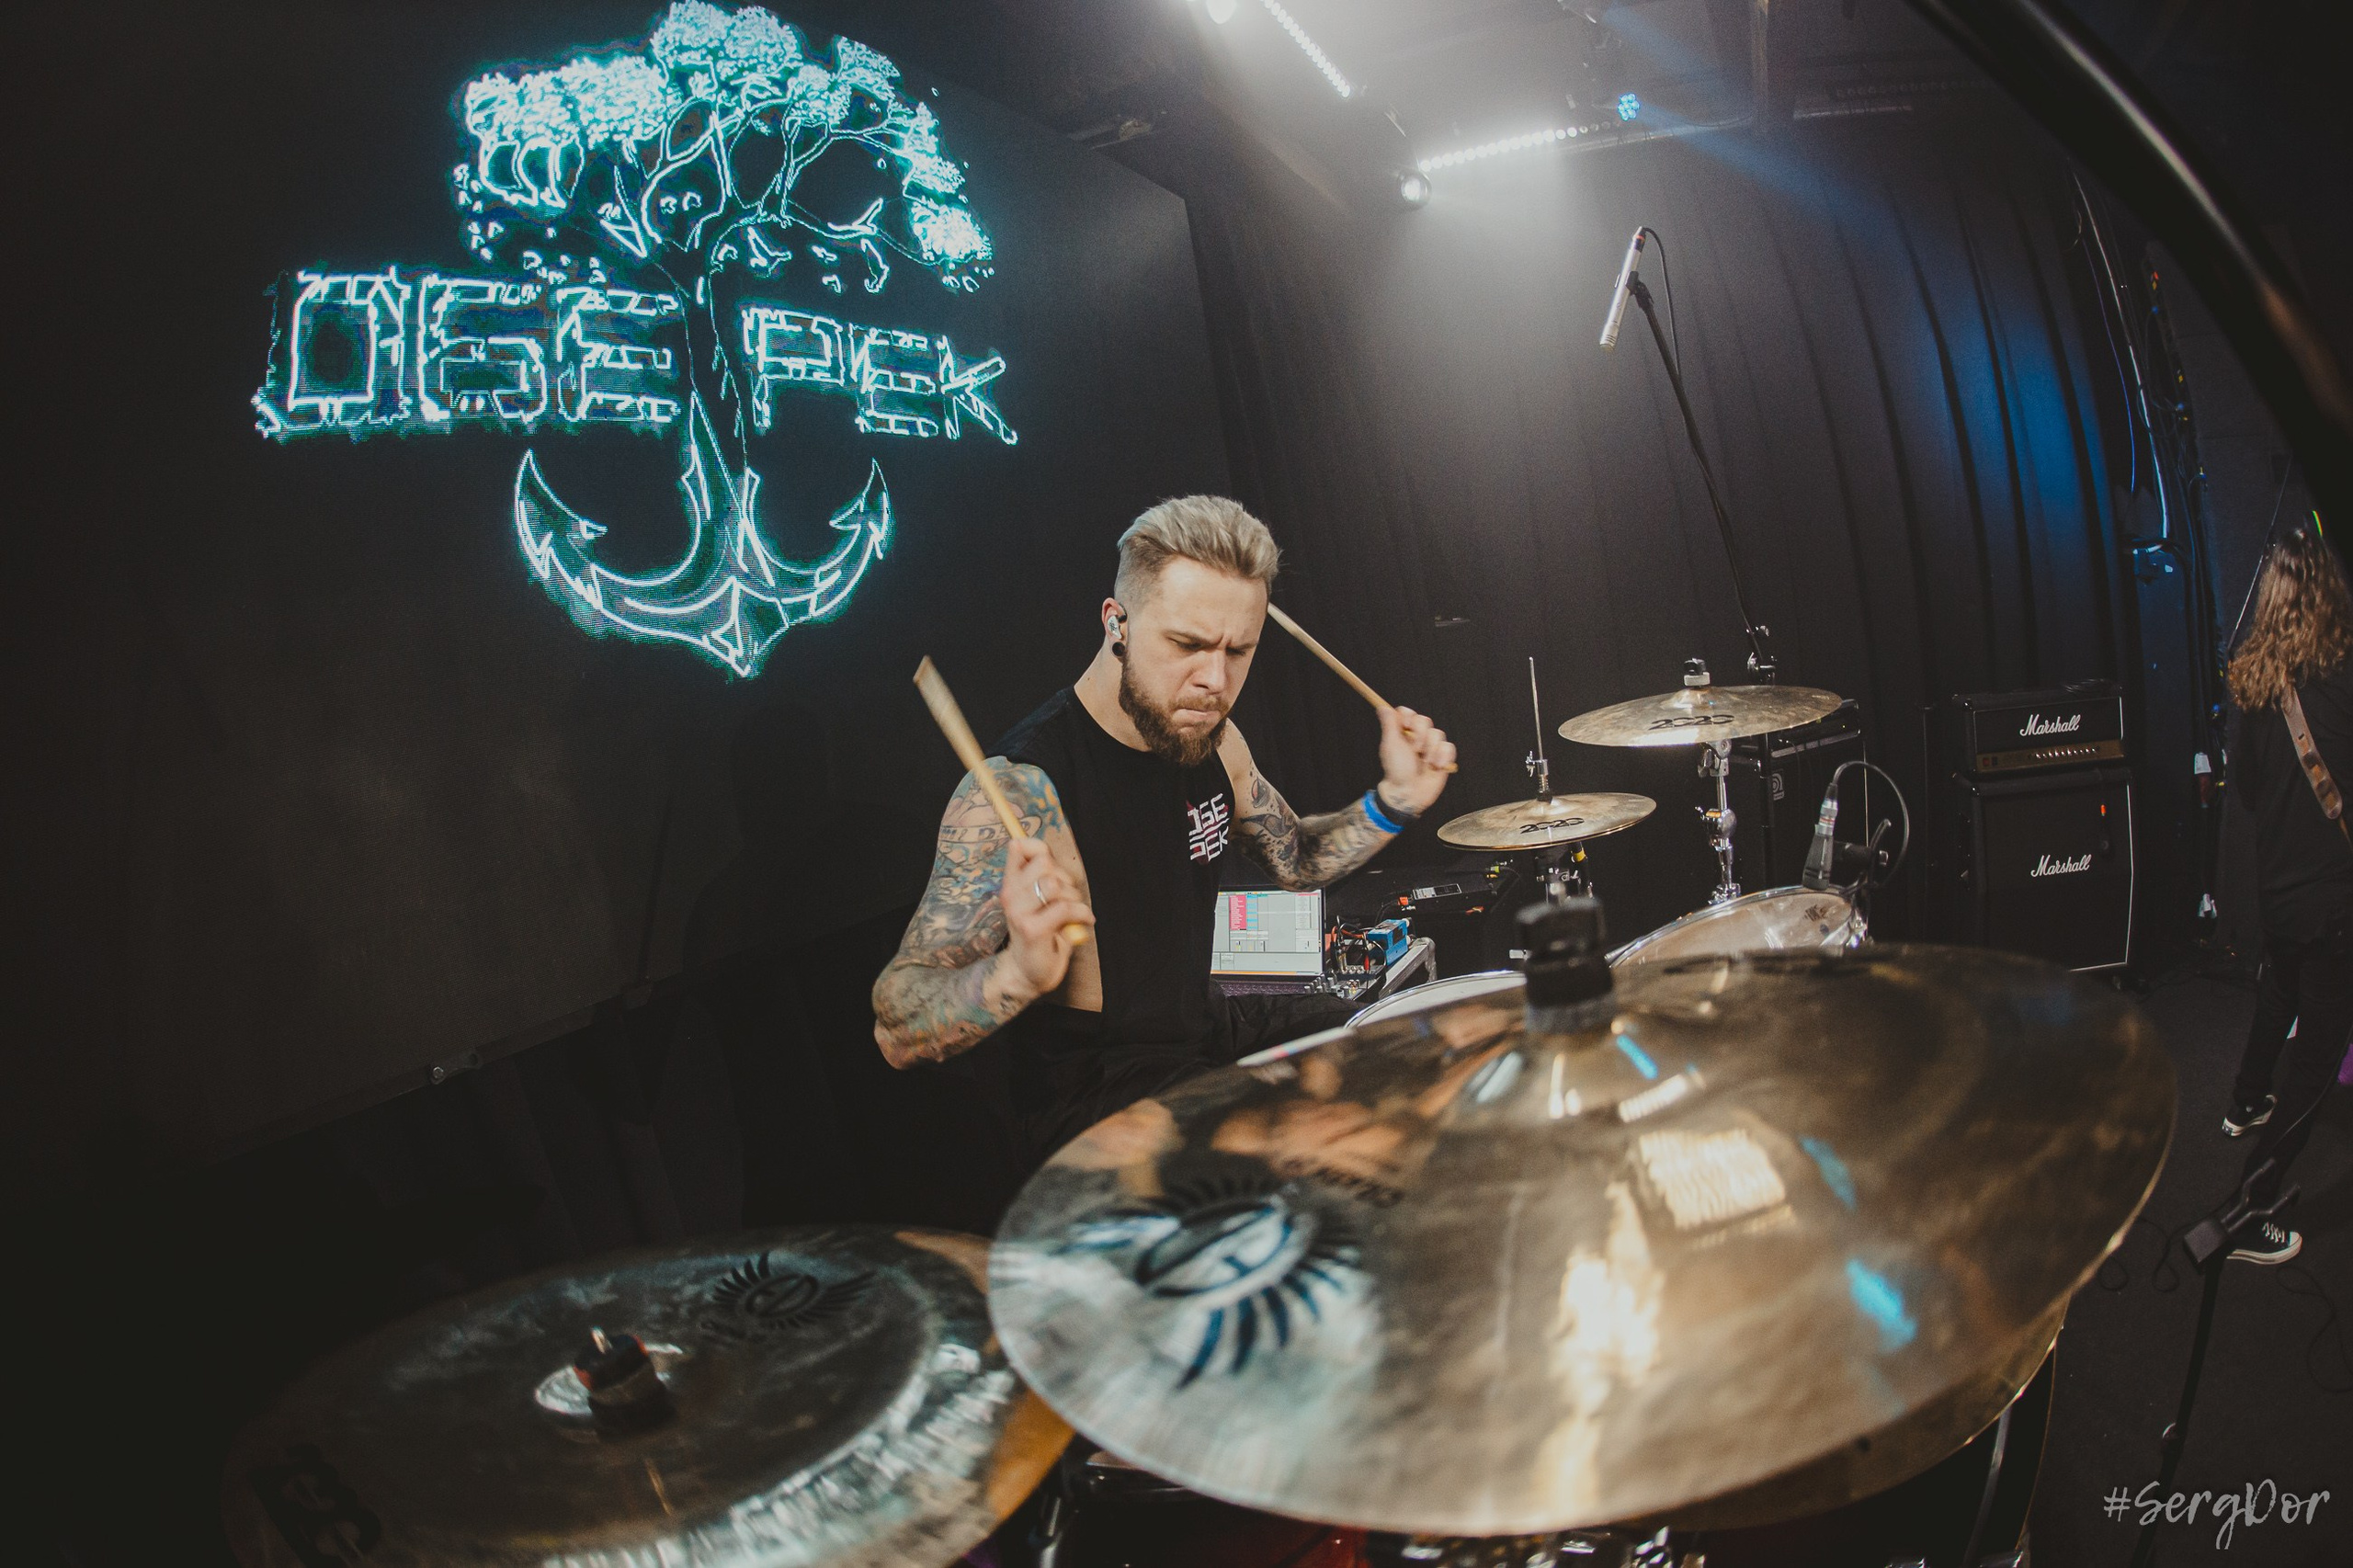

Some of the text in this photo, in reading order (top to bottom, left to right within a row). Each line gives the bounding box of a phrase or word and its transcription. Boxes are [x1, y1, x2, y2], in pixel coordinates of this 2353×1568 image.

[1648, 713, 1735, 731] 2020
[2019, 713, 2082, 737] Marshall
[1518, 817, 1586, 835] 2020
[2030, 854, 2093, 878] Marshall
